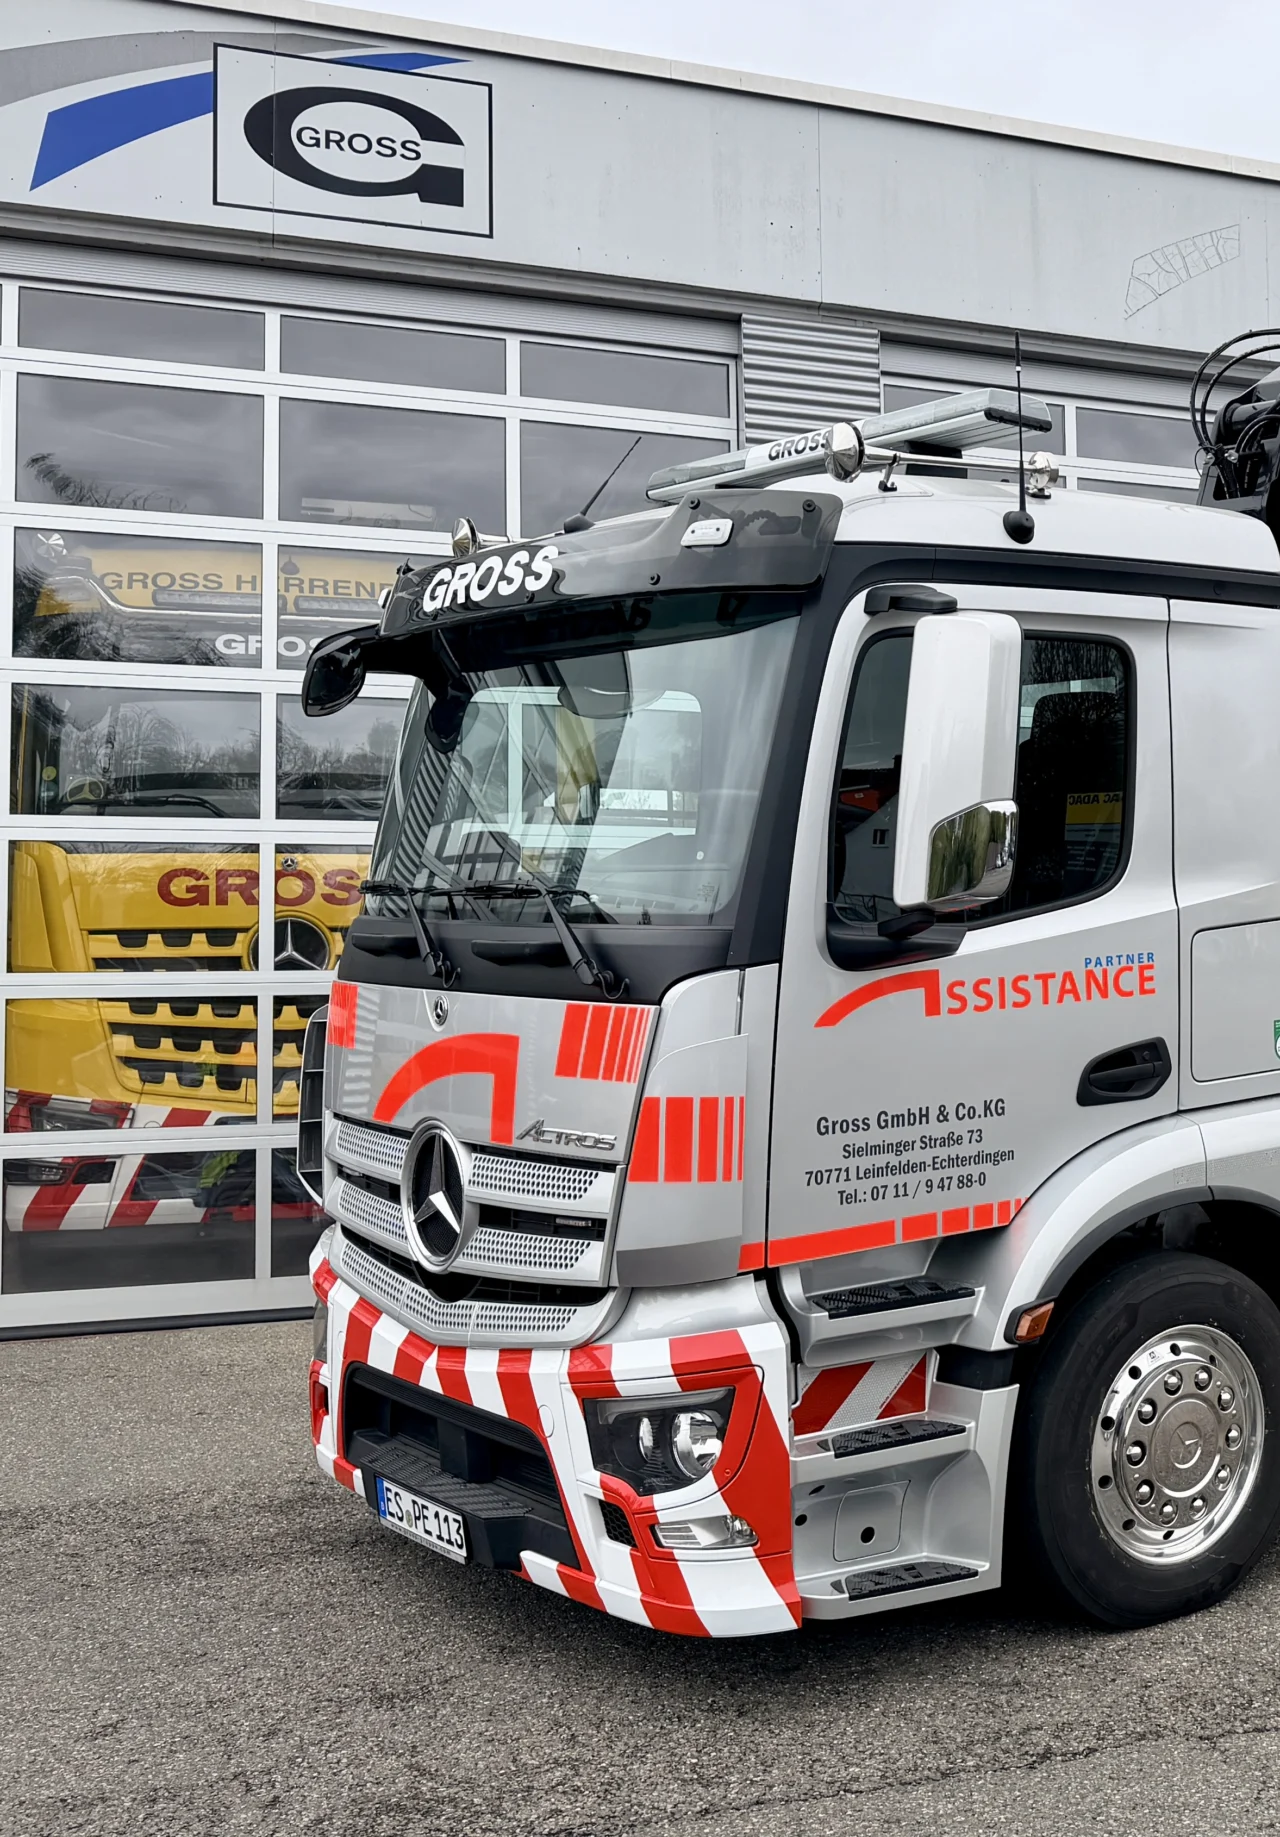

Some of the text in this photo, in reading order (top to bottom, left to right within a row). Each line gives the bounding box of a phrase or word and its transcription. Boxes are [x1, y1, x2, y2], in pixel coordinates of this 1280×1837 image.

[296, 126, 422, 161] GROSS
[102, 572, 223, 591] GROSS
[423, 545, 559, 613] GROSS
[1084, 951, 1155, 969] PARTNER
[816, 1098, 1006, 1136] Gross GmbH & Co.KG
[842, 1128, 983, 1159] Sielminger Straße 73
[805, 1149, 1015, 1187] 70771 Leinfelden-Echterdingen
[837, 1171, 987, 1206] Tel.: 07 11 / 9 47 88-0
[384, 1485, 464, 1550] ES PE 113
